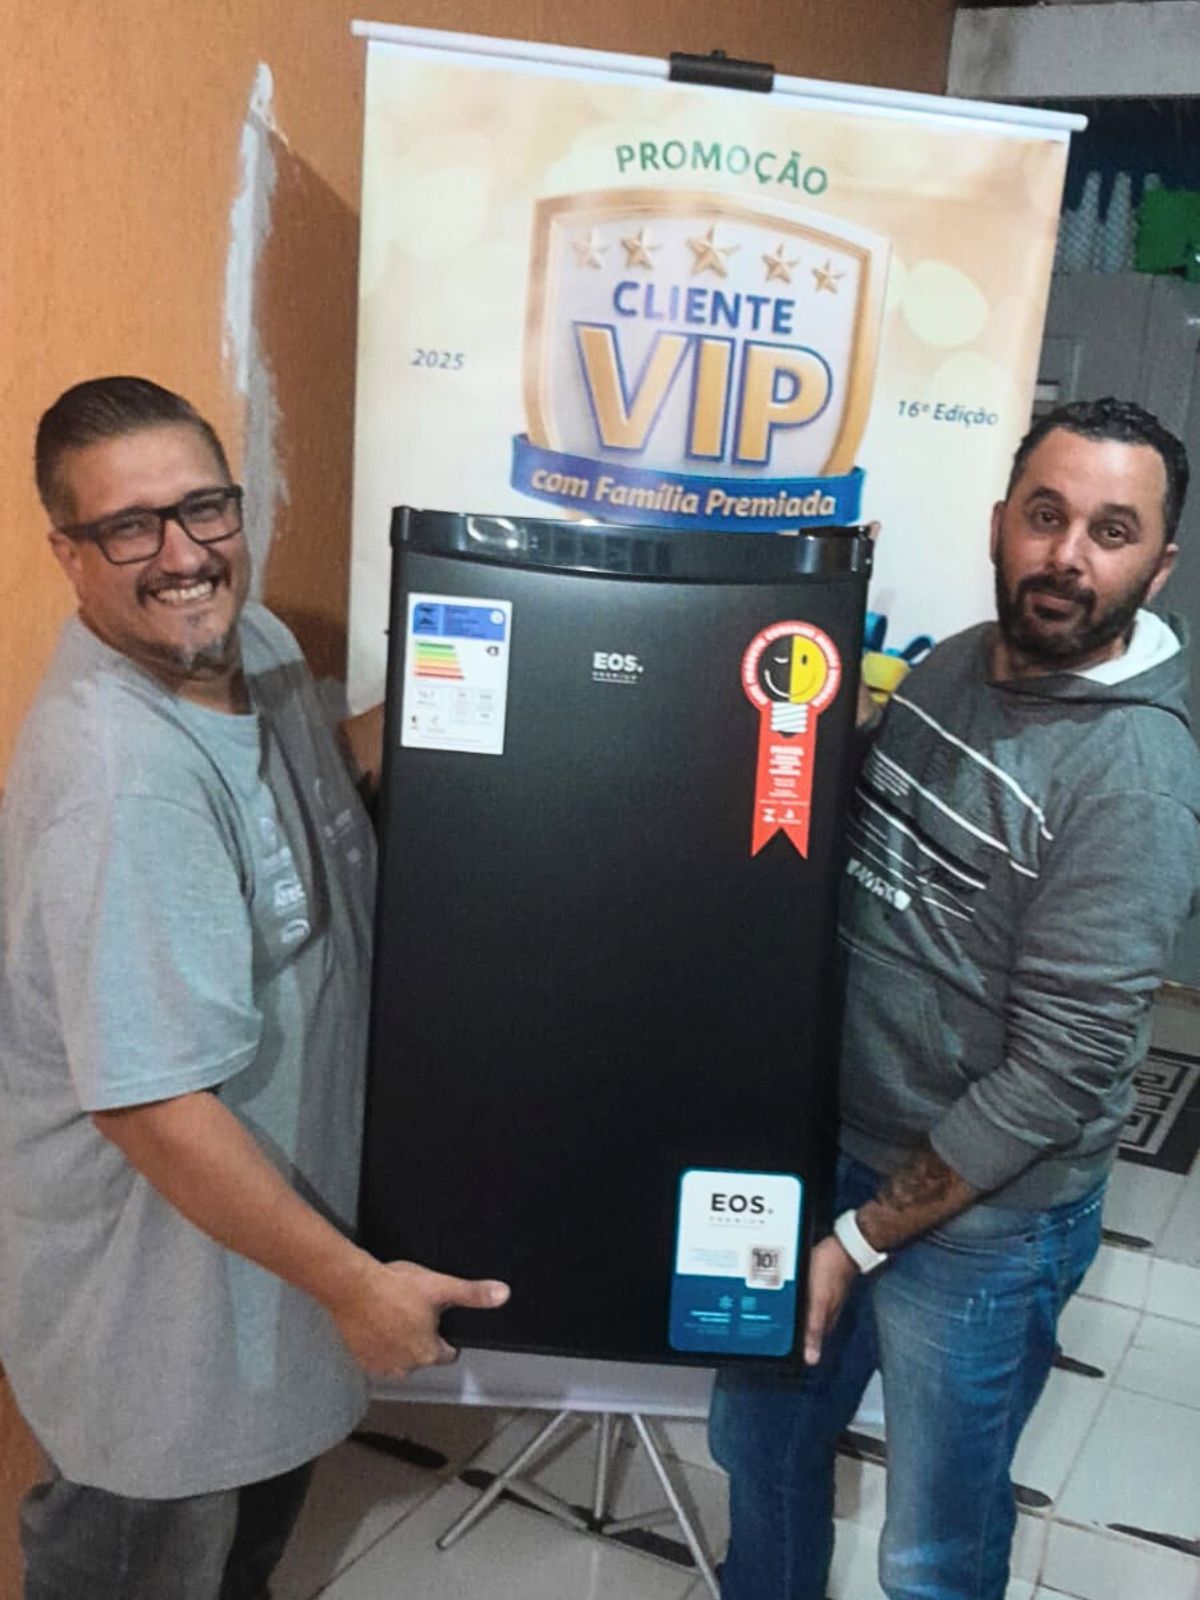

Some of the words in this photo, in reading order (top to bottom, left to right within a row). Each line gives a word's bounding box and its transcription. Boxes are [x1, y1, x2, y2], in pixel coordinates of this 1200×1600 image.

[615, 140, 828, 196] PROMOÇÃO
[612, 280, 796, 335] CLIENTE
[411, 348, 465, 371] 2025
[572, 320, 833, 467] VIP
[932, 402, 999, 428] Edição
[531, 468, 590, 499] com
[595, 478, 700, 515] Família
[704, 487, 837, 519] Premiada
